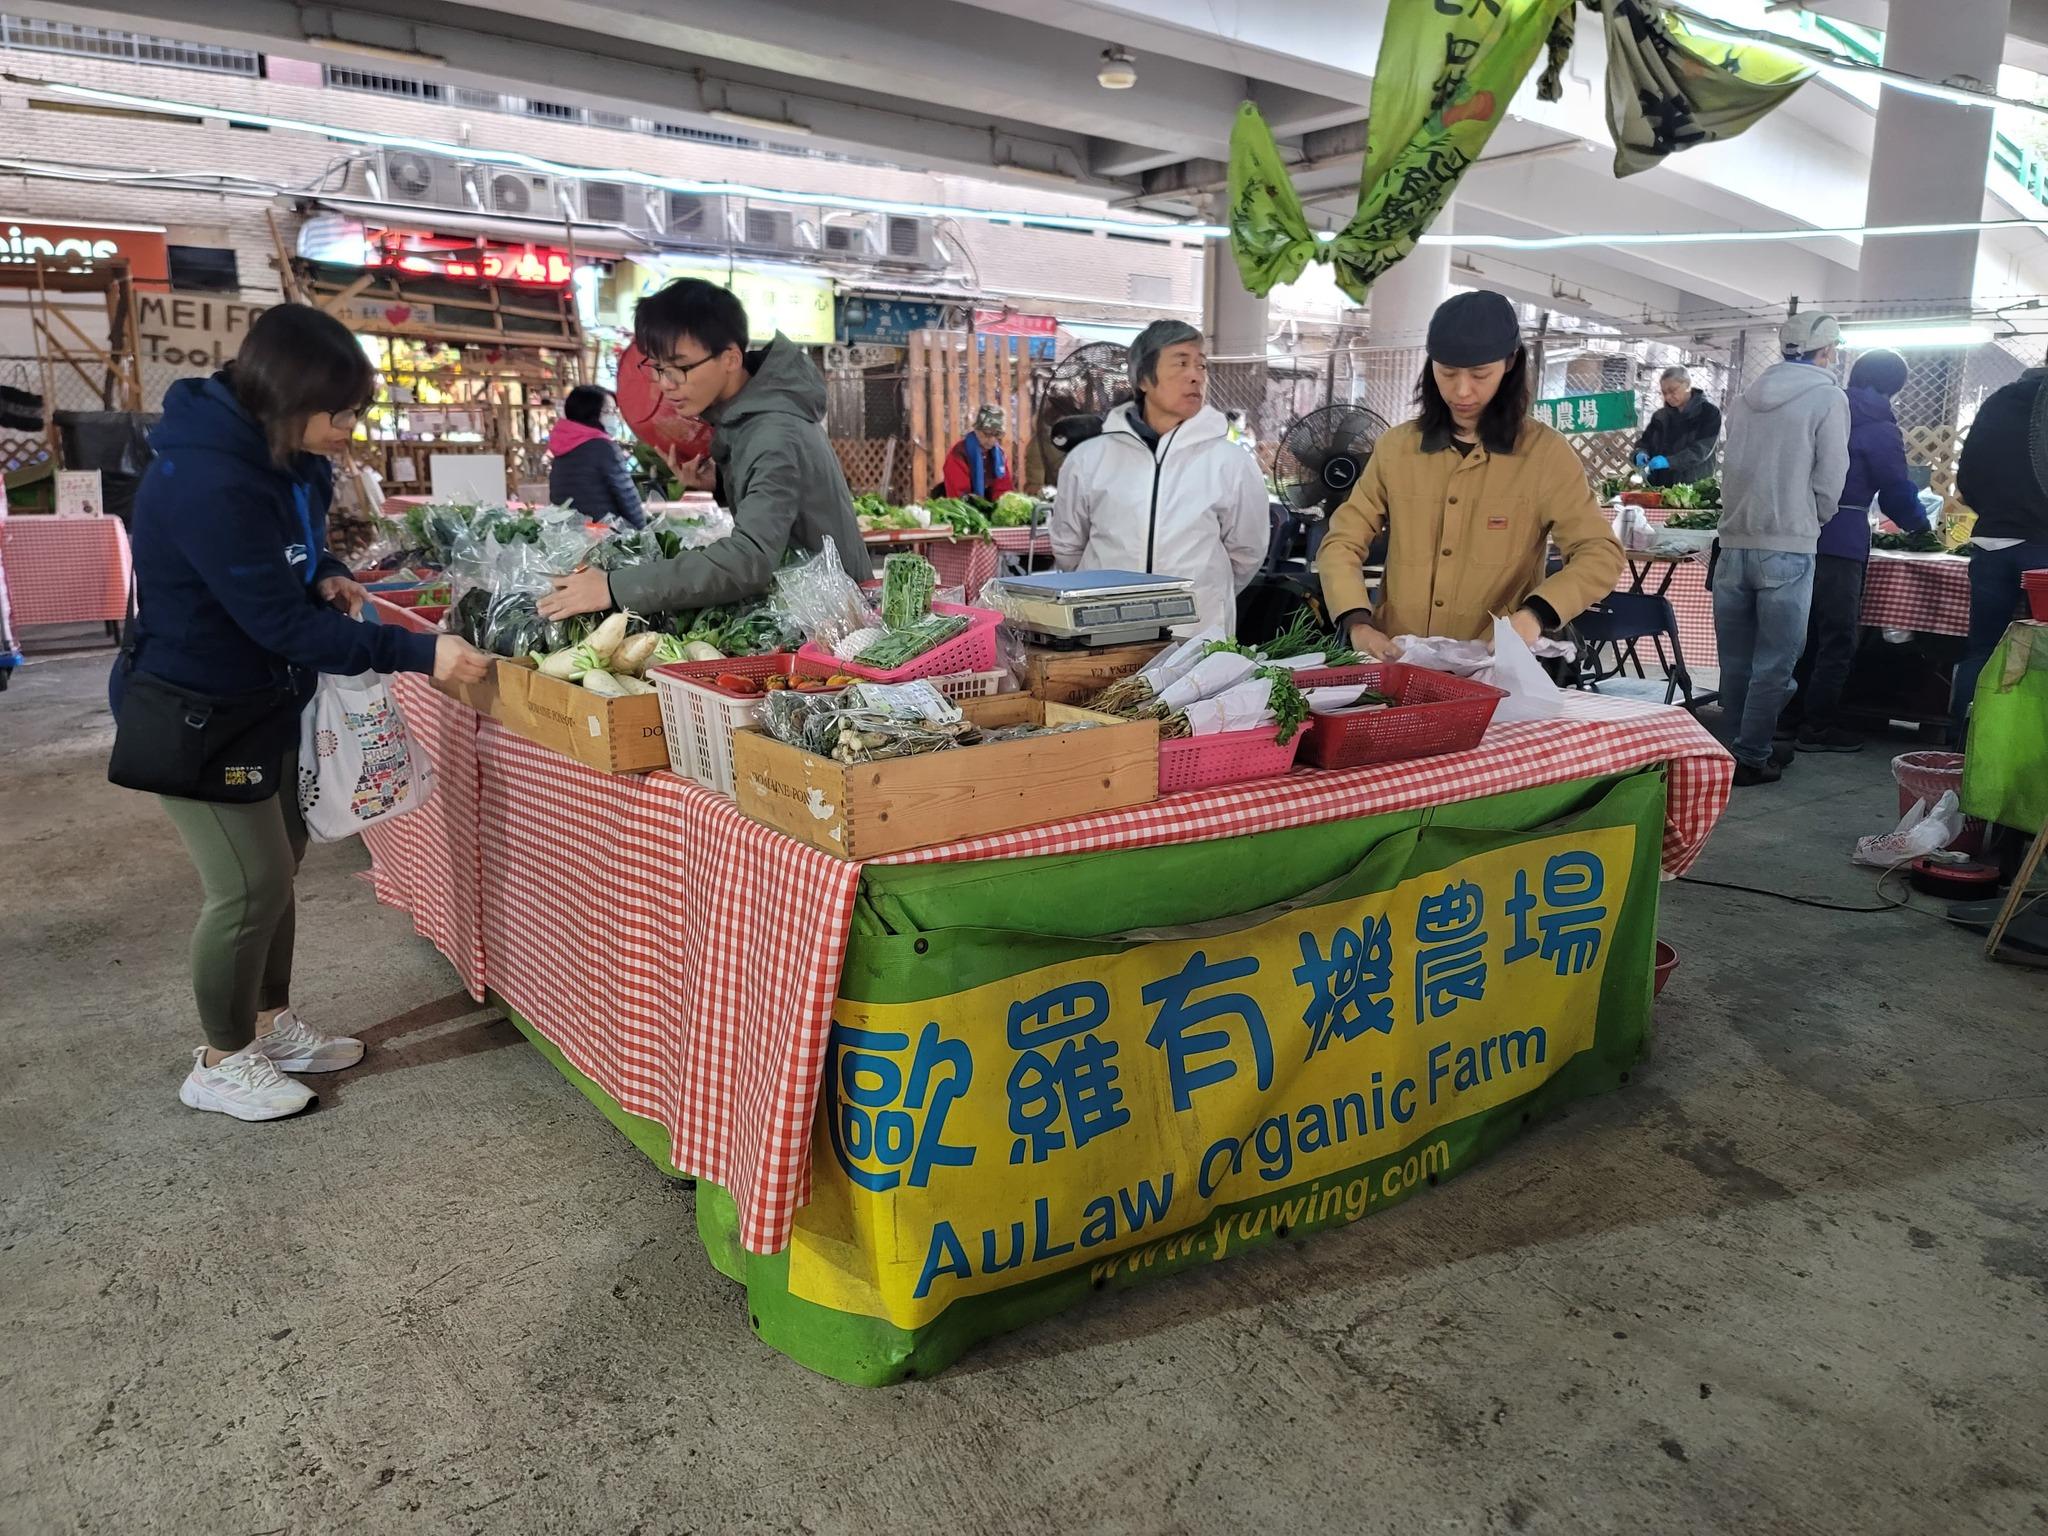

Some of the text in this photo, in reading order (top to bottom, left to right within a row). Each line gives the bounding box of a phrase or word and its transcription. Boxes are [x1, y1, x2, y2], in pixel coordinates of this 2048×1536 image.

[0, 226, 119, 273] ings
[140, 297, 212, 331] MEI
[142, 333, 222, 368] Tool
[825, 850, 1607, 1192] 歐羅有機農場
[912, 1172, 1174, 1300] AuLaw
[1428, 1025, 1547, 1106] Farm
[1089, 1138, 1450, 1286] www.yuwing.com
